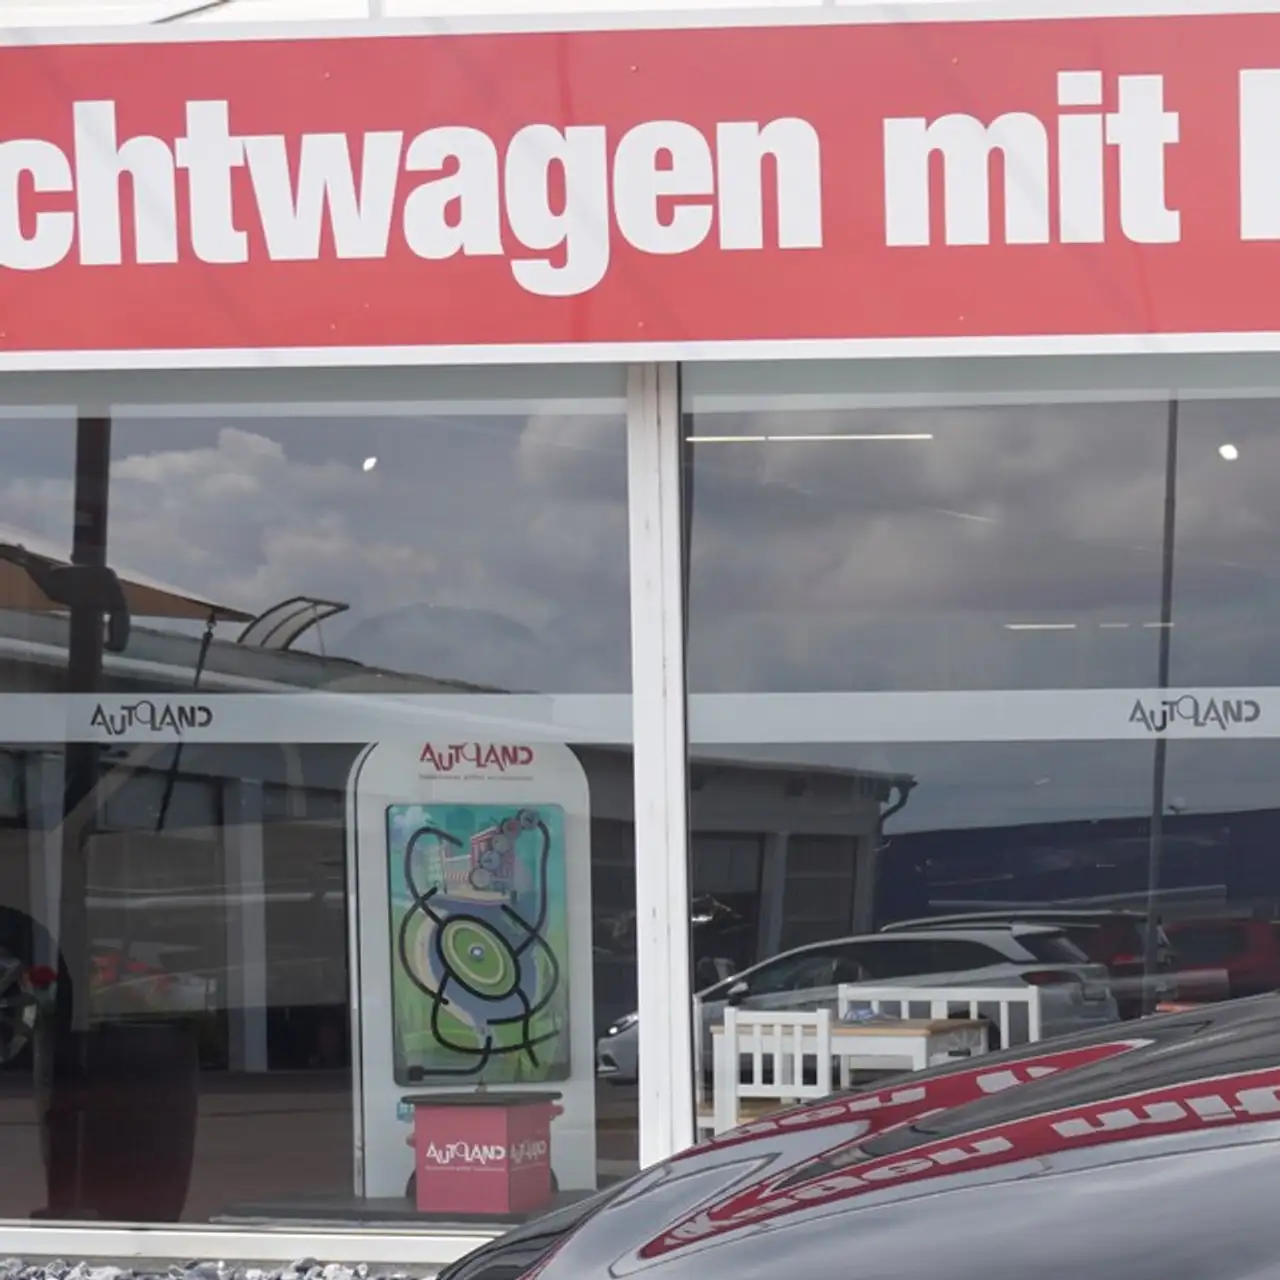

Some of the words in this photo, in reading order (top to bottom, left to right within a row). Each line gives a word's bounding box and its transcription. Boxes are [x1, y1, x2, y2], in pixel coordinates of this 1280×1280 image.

[0, 100, 823, 297] chtwagen
[882, 70, 1181, 248] mit
[90, 700, 213, 735] AUTOLAND
[1129, 695, 1260, 731] AUTOLAND
